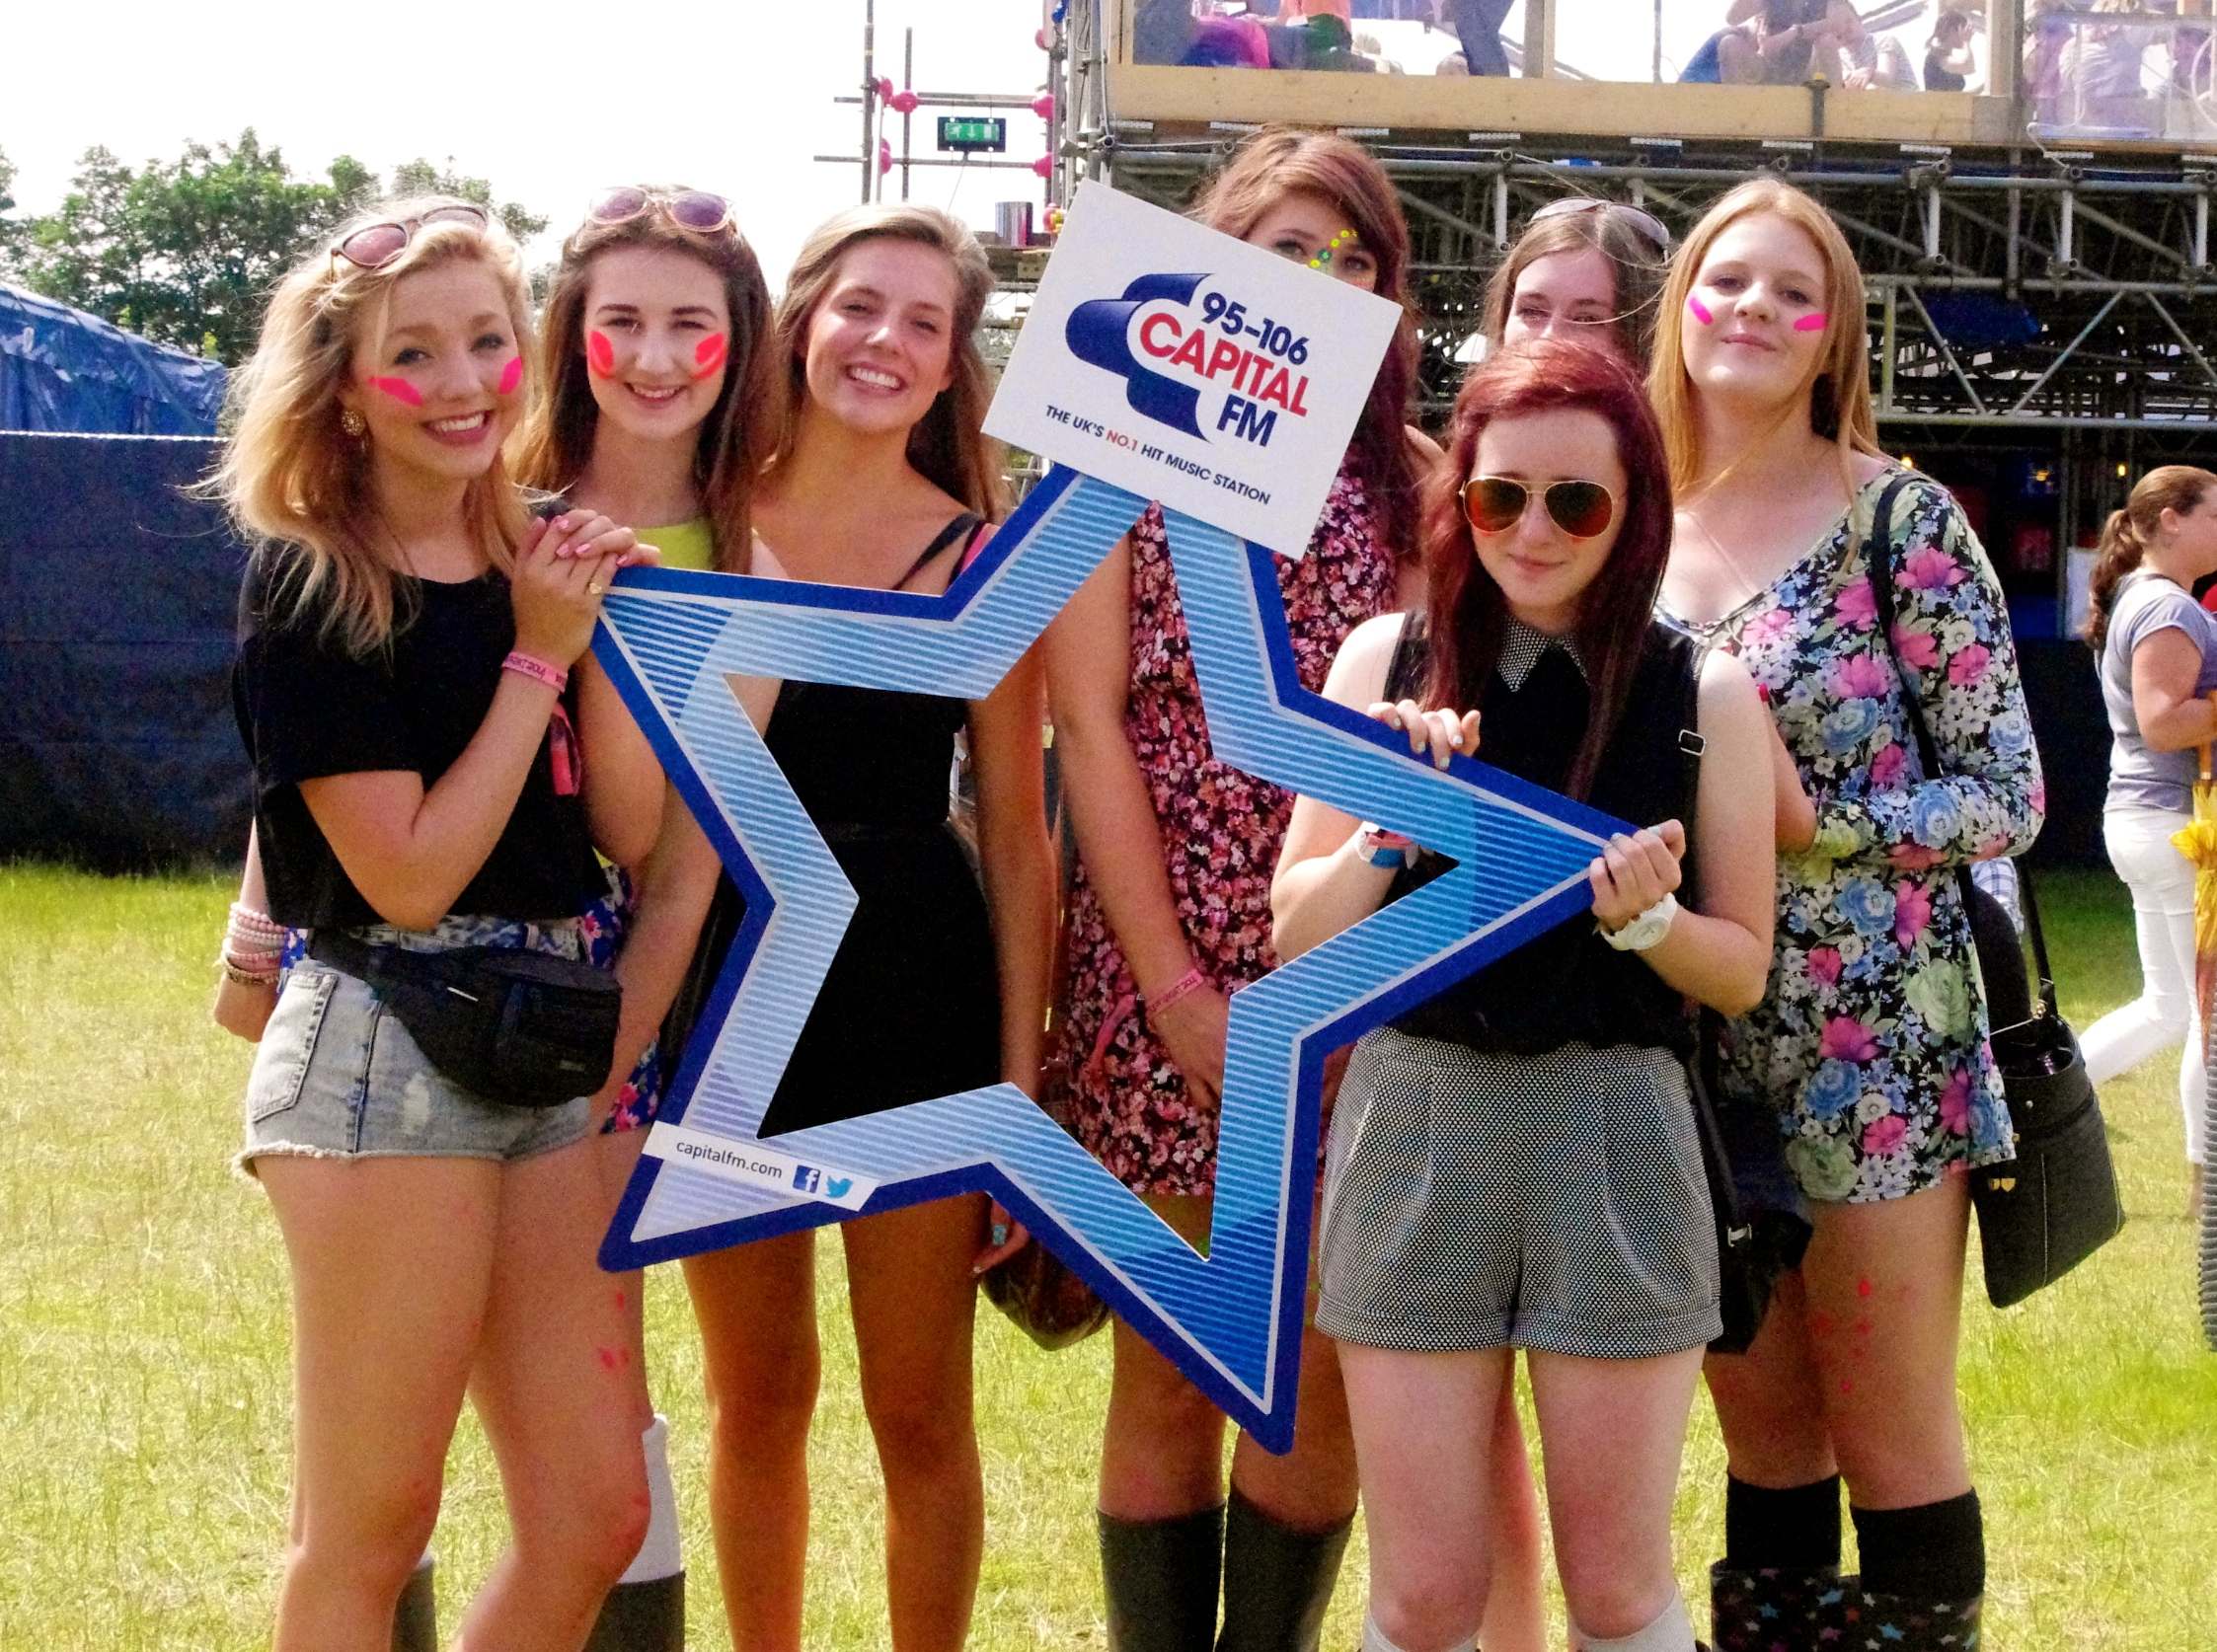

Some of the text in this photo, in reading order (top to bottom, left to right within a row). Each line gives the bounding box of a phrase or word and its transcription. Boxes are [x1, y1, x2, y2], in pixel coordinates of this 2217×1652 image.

[1140, 313, 1309, 416] CAPITAL
[1202, 292, 1310, 366] 95-106
[1046, 405, 1271, 505] THE UK'S NO.1 HIT MUSIC STATION
[1217, 394, 1278, 447] FM
[676, 1141, 783, 1179] capitalfm.com
